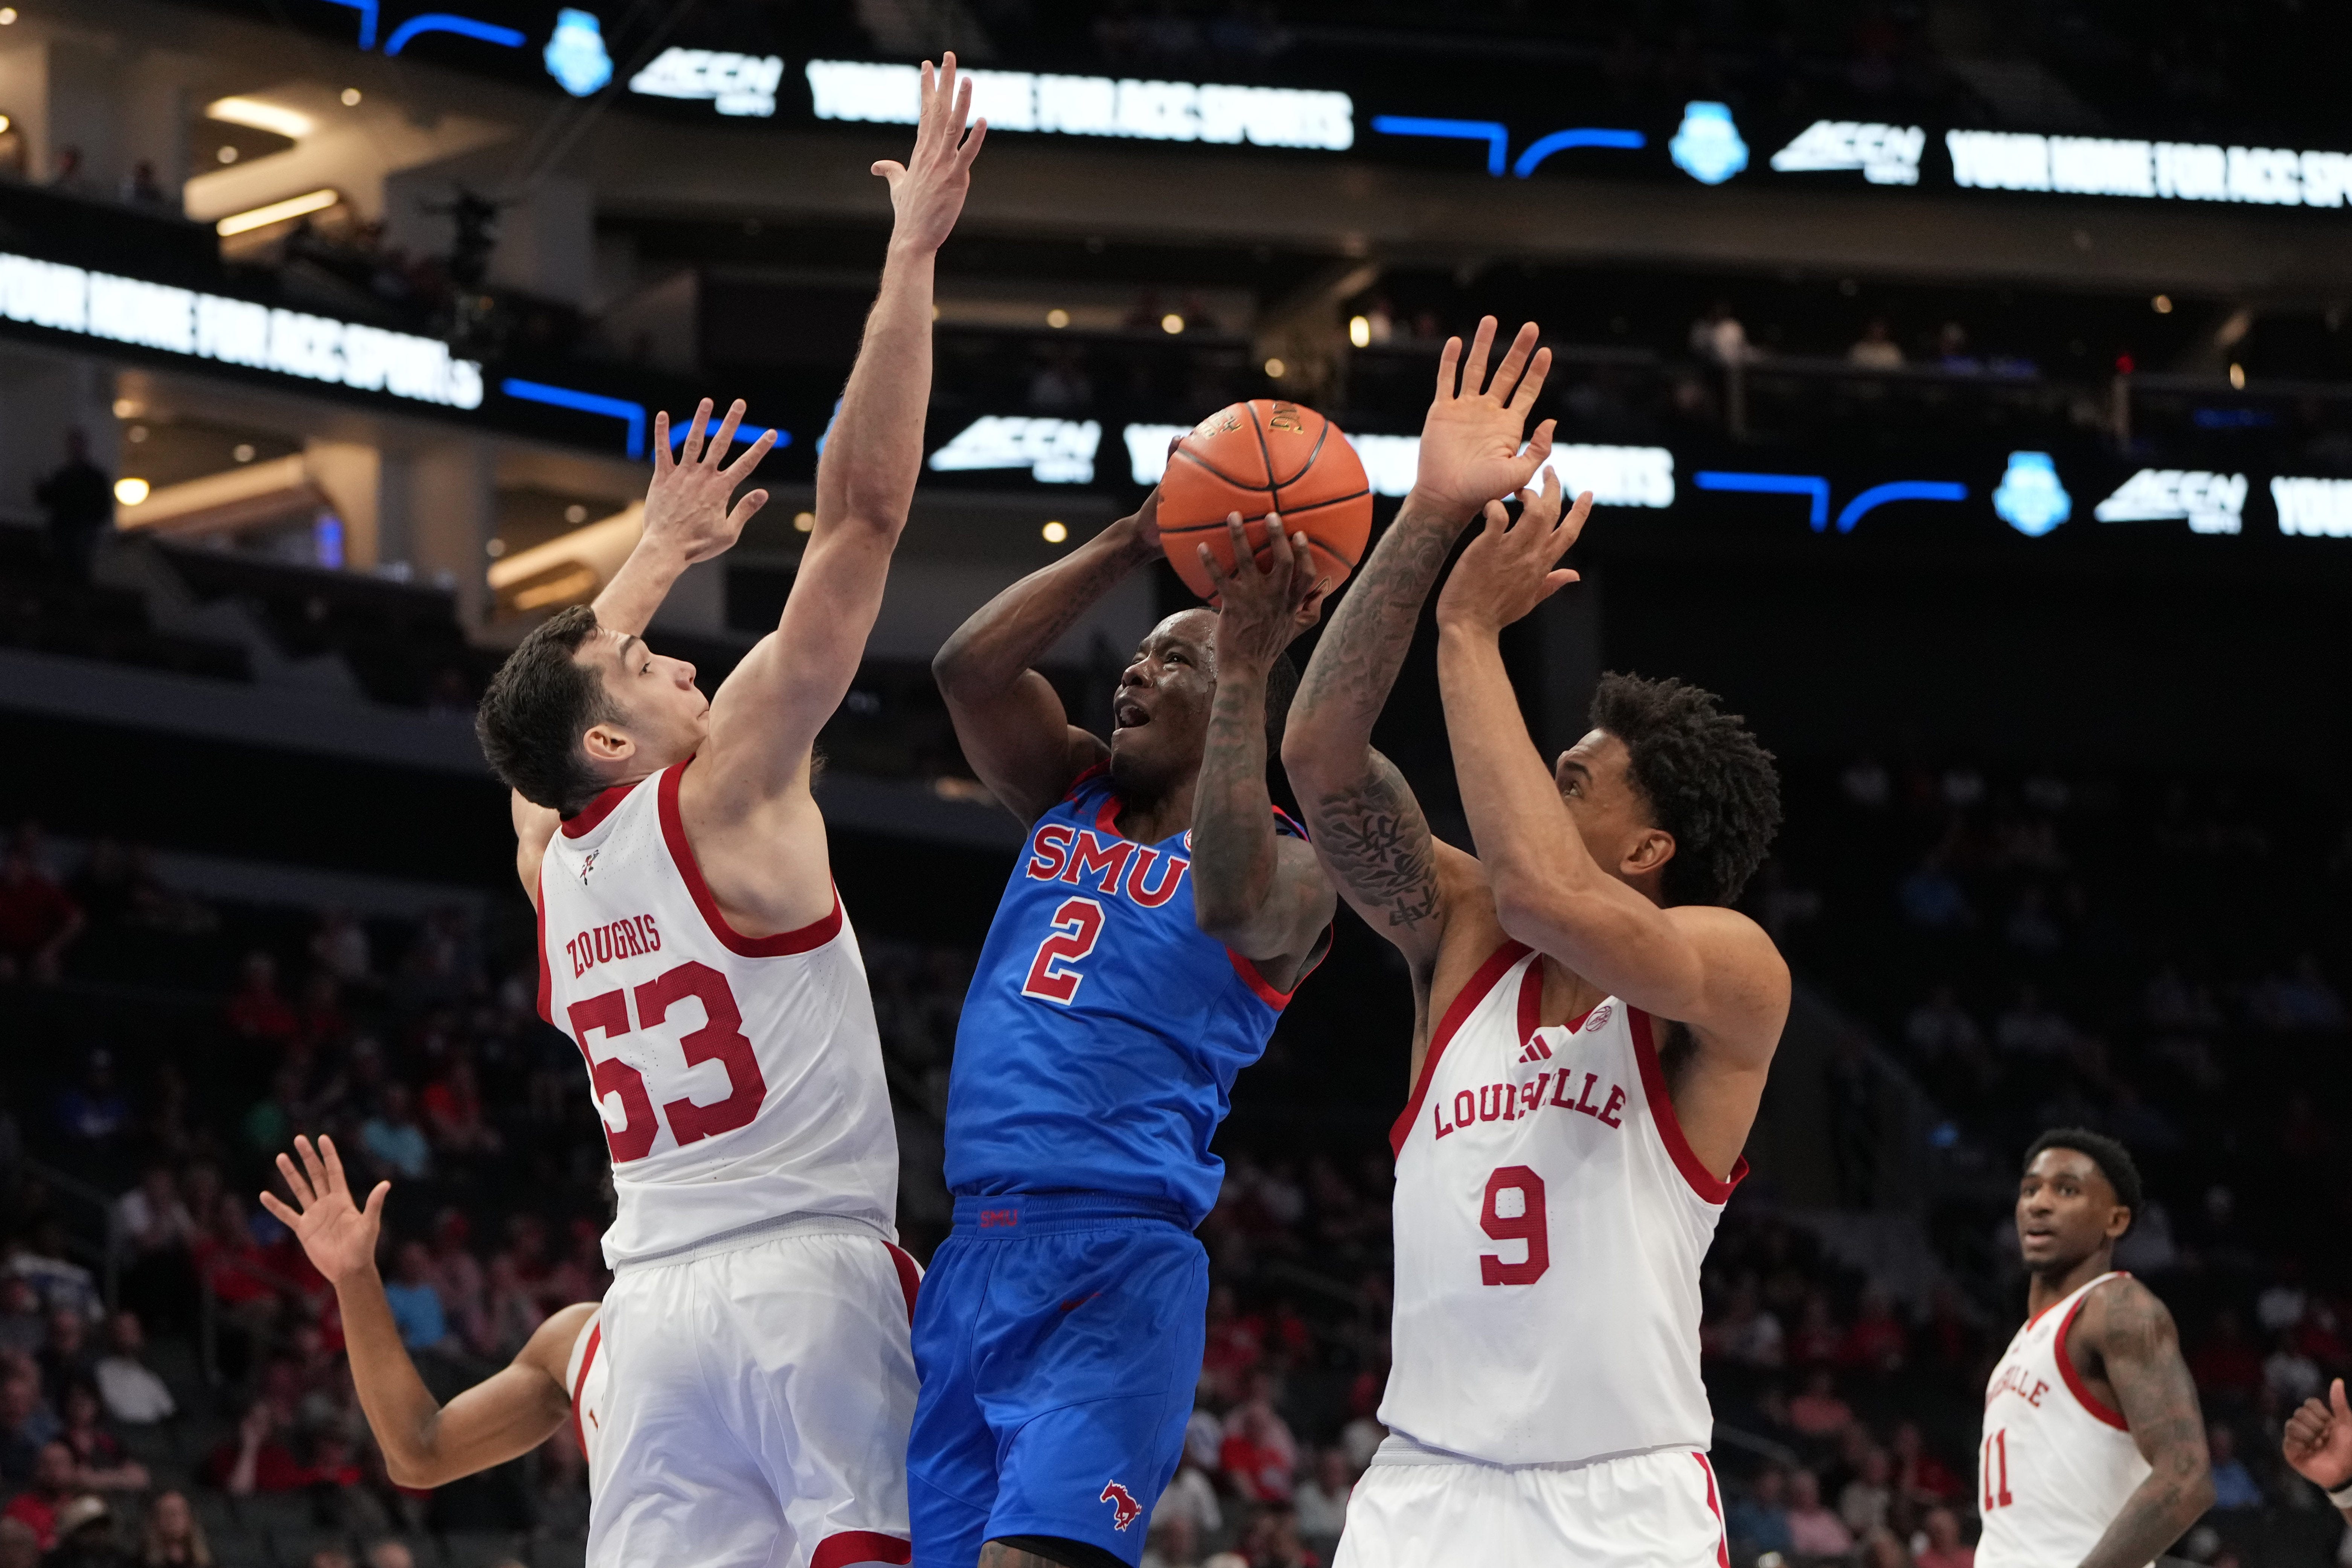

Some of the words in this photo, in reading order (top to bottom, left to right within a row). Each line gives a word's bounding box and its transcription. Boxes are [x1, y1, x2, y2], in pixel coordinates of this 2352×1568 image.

[1116, 78, 1198, 142] ACC
[1198, 84, 1353, 151] SPORTS
[2155, 141, 2226, 201] FOR
[2227, 146, 2301, 206] ACC
[197, 292, 269, 369] FOR
[269, 307, 346, 384] ACC
[1026, 823, 1190, 908] SMU
[566, 913, 661, 979] ZOUGRIS
[1021, 896, 1105, 1006] 2
[567, 960, 767, 1163] 53
[1435, 1068, 1626, 1140] LOUISVLLE
[981, 1209, 1018, 1228] SMU
[1480, 1165, 1549, 1286] 9
[1985, 1428, 2012, 1512] 11
